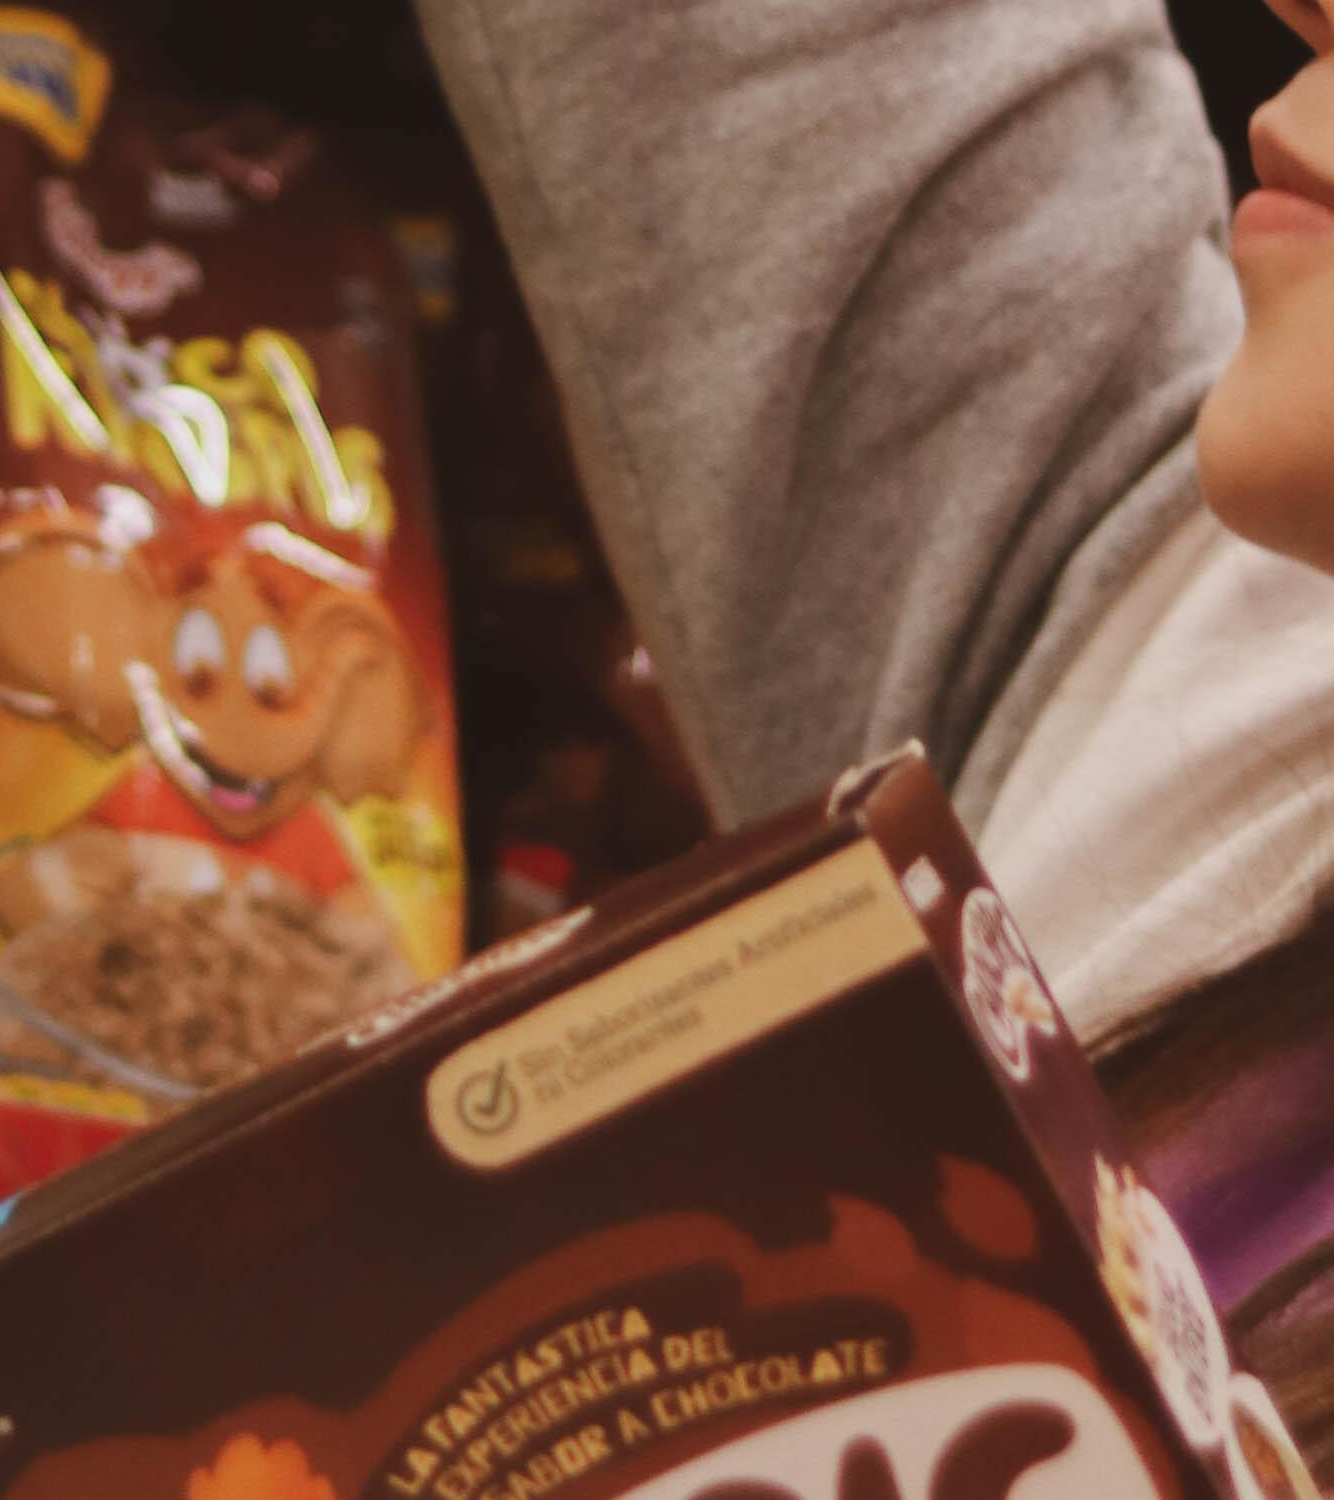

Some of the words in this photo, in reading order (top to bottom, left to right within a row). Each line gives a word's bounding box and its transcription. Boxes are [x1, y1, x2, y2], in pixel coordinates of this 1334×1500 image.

[661, 1326, 734, 1373] DEL
[616, 1407, 650, 1446] A
[650, 1336, 890, 1432] CHOCOLATE
[388, 1446, 441, 1496] LA
